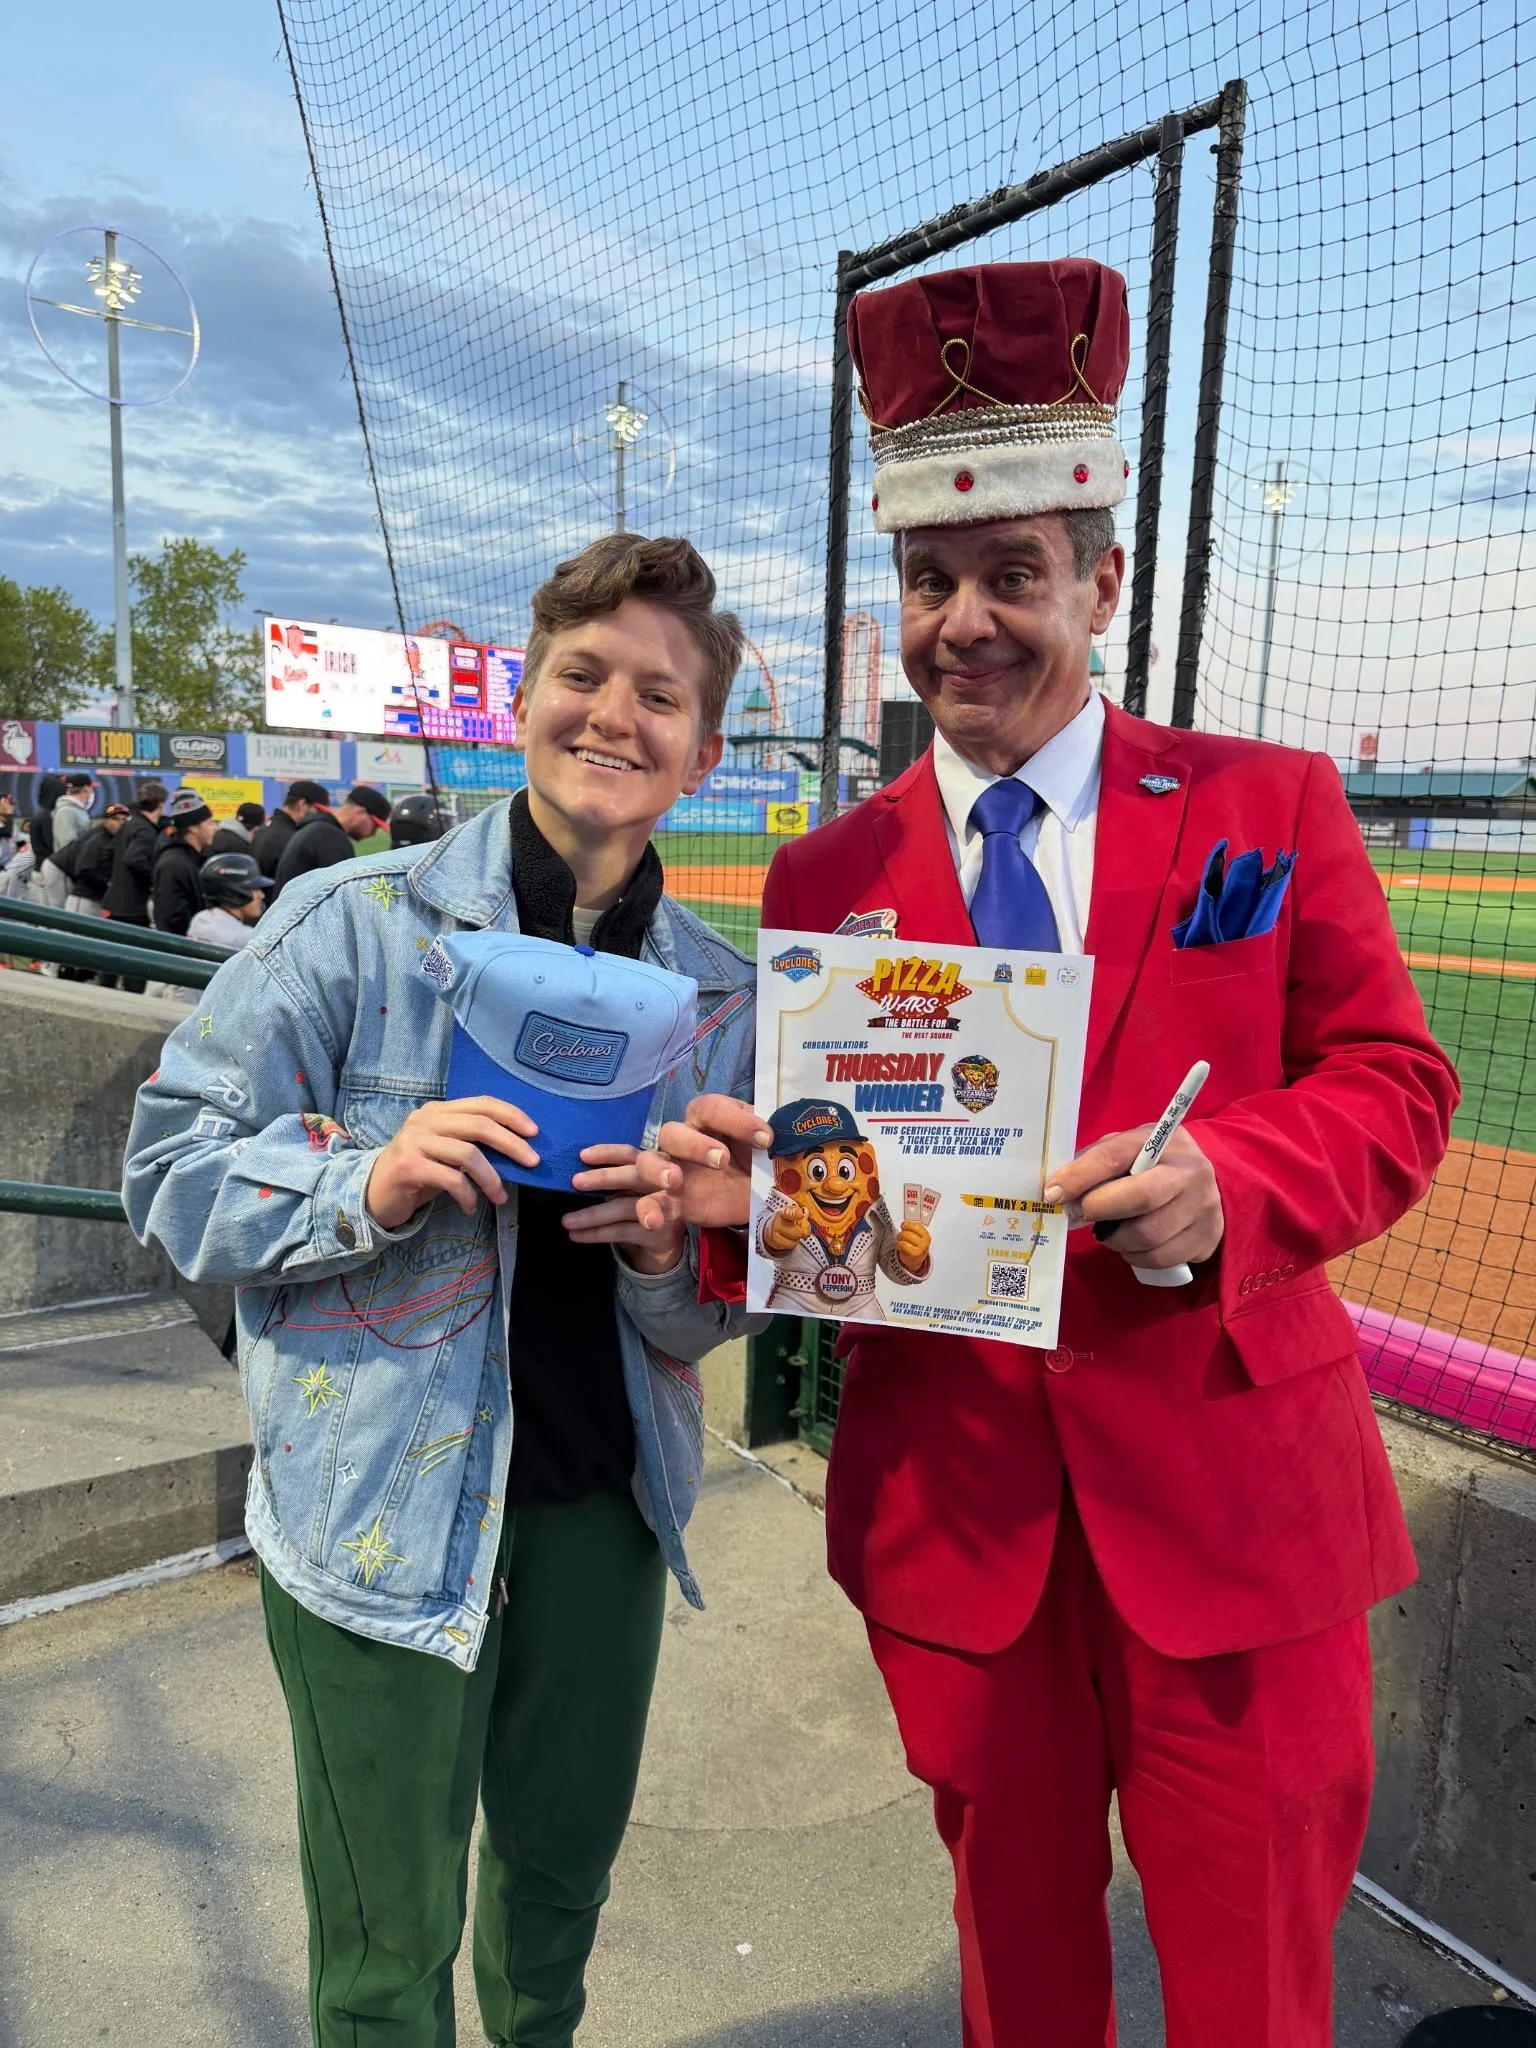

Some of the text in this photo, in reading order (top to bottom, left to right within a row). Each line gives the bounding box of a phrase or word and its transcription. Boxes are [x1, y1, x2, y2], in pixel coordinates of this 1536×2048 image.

[65, 729, 160, 759] FILM FOOD FUN
[256, 738, 329, 761] Fairfield
[773, 957, 818, 972] CYCLONES
[872, 957, 962, 995] PIZZA
[879, 995, 939, 1014] WARS
[884, 1018, 947, 1028] THE BATTLE FOR
[532, 1033, 612, 1066] Cyclones
[802, 1041, 868, 1050] CONGRATULATIONS
[825, 1053, 945, 1082] THURSDAY
[854, 1083, 945, 1113] WINNER
[796, 1116, 839, 1133] CYCLONES
[880, 1126, 1023, 1137] THIS CERTIFICATE ENTITLES YOU TO
[898, 1136, 1005, 1146] 2 TICKETS TO PIZZA WARS
[1144, 1120, 1173, 1159] Sharpie
[902, 1145, 1002, 1156] IN BAY RIDGE BROOKLYN
[994, 1198, 1028, 1211] MAY 3
[824, 1273, 852, 1285] TONY
[822, 1284, 853, 1293] PEPPERONI
